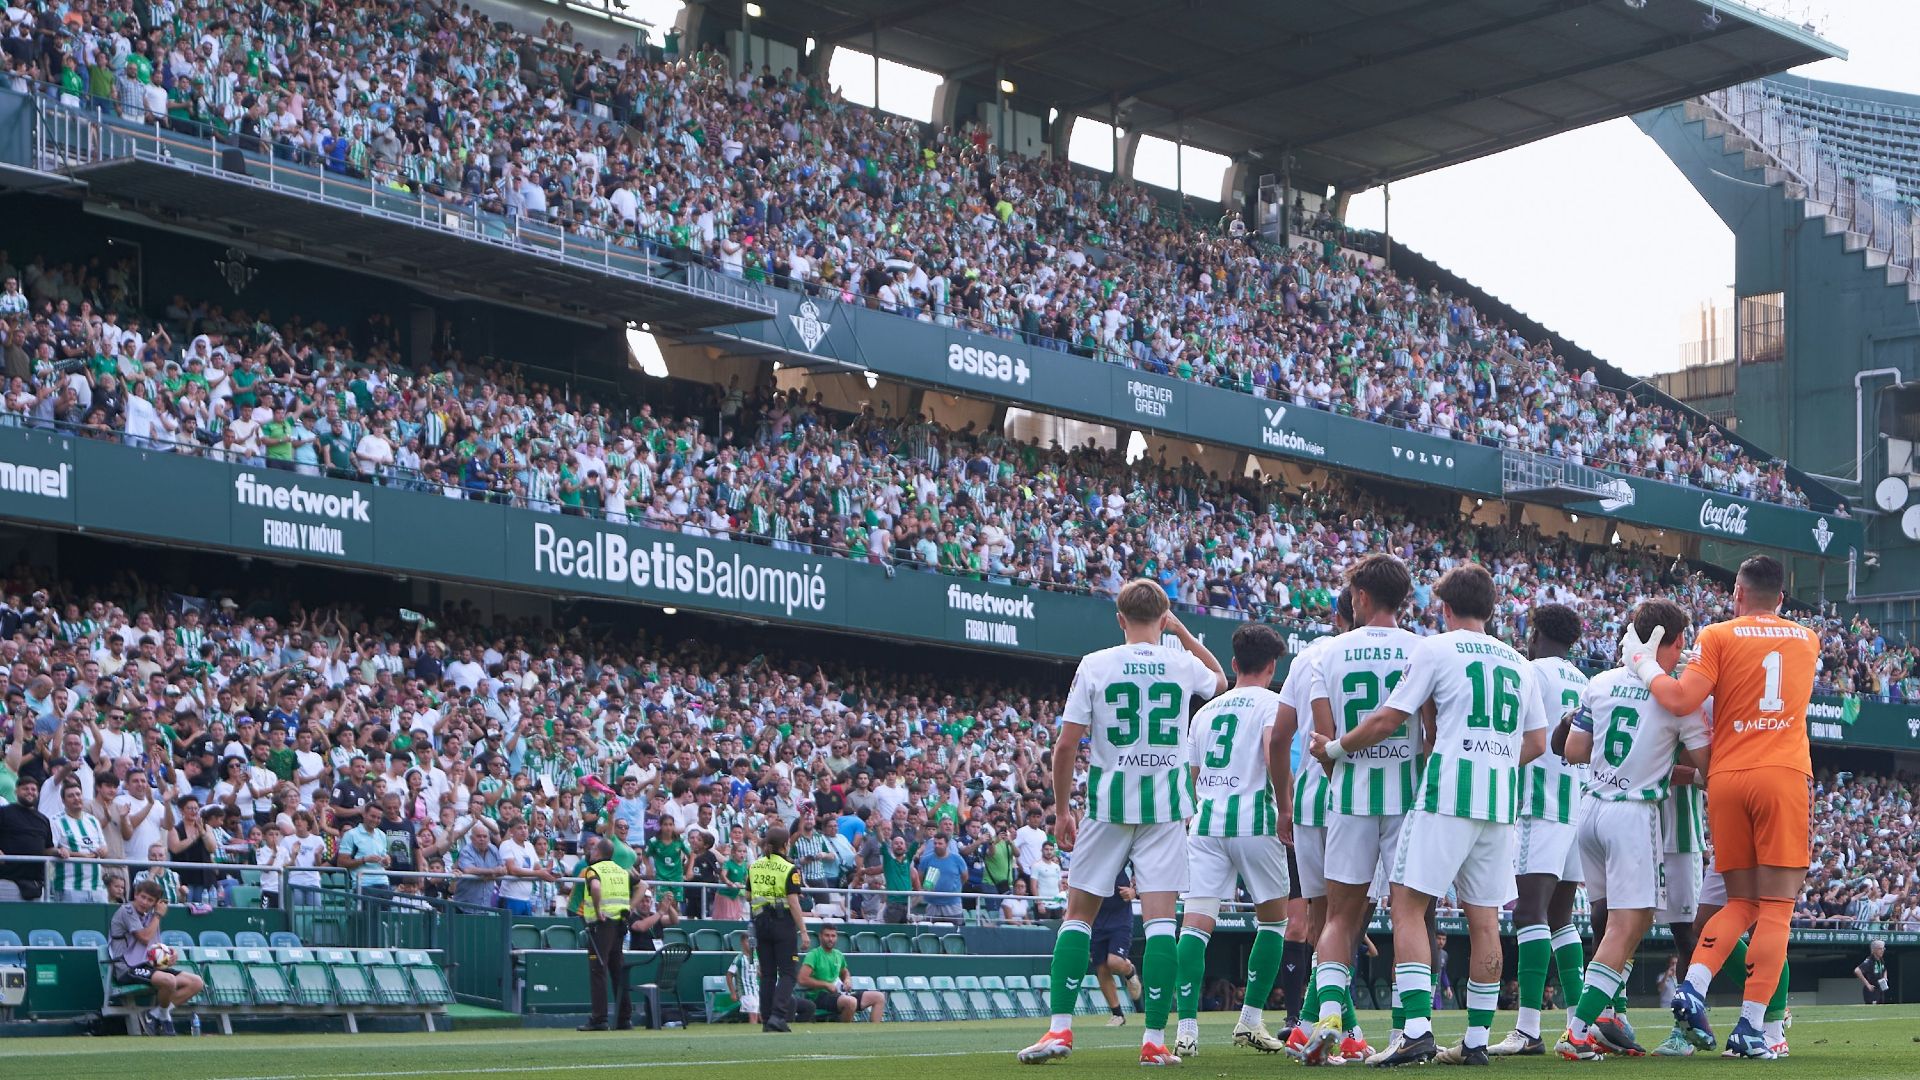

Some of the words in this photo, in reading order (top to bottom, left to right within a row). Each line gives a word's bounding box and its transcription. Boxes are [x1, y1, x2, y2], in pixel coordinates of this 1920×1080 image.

[948, 343, 1012, 381] asisa
[1127, 380, 1173, 404] FOREVER
[1135, 397, 1166, 417] GREEN
[1262, 426, 1305, 451] Halcón
[1392, 446, 1455, 468] VOLVO
[235, 472, 370, 522] finetwork
[263, 519, 299, 549] FIBRA
[299, 523, 308, 550] Y
[309, 523, 345, 555] MÓVIL
[947, 583, 1035, 619] finetwork
[965, 618, 988, 642] FIBRA
[988, 622, 994, 643] Y
[995, 621, 1019, 646] MÓVIL
[1733, 626, 1809, 641] GUILHERME
[1345, 648, 1391, 662] LUCAS
[1609, 685, 1651, 701] MATEO
[1759, 651, 1784, 713] 1
[1342, 670, 1410, 740] 21
[1465, 661, 1522, 736] 16
[1104, 681, 1184, 748] 32
[1744, 716, 1795, 732] MEDAC
[1204, 713, 1239, 770] 3
[1604, 705, 1641, 769] 6
[1124, 753, 1177, 767] MEDAC
[1355, 744, 1410, 760] MEDAC
[1198, 775, 1240, 788] MEDAC
[753, 873, 776, 886] 2383
